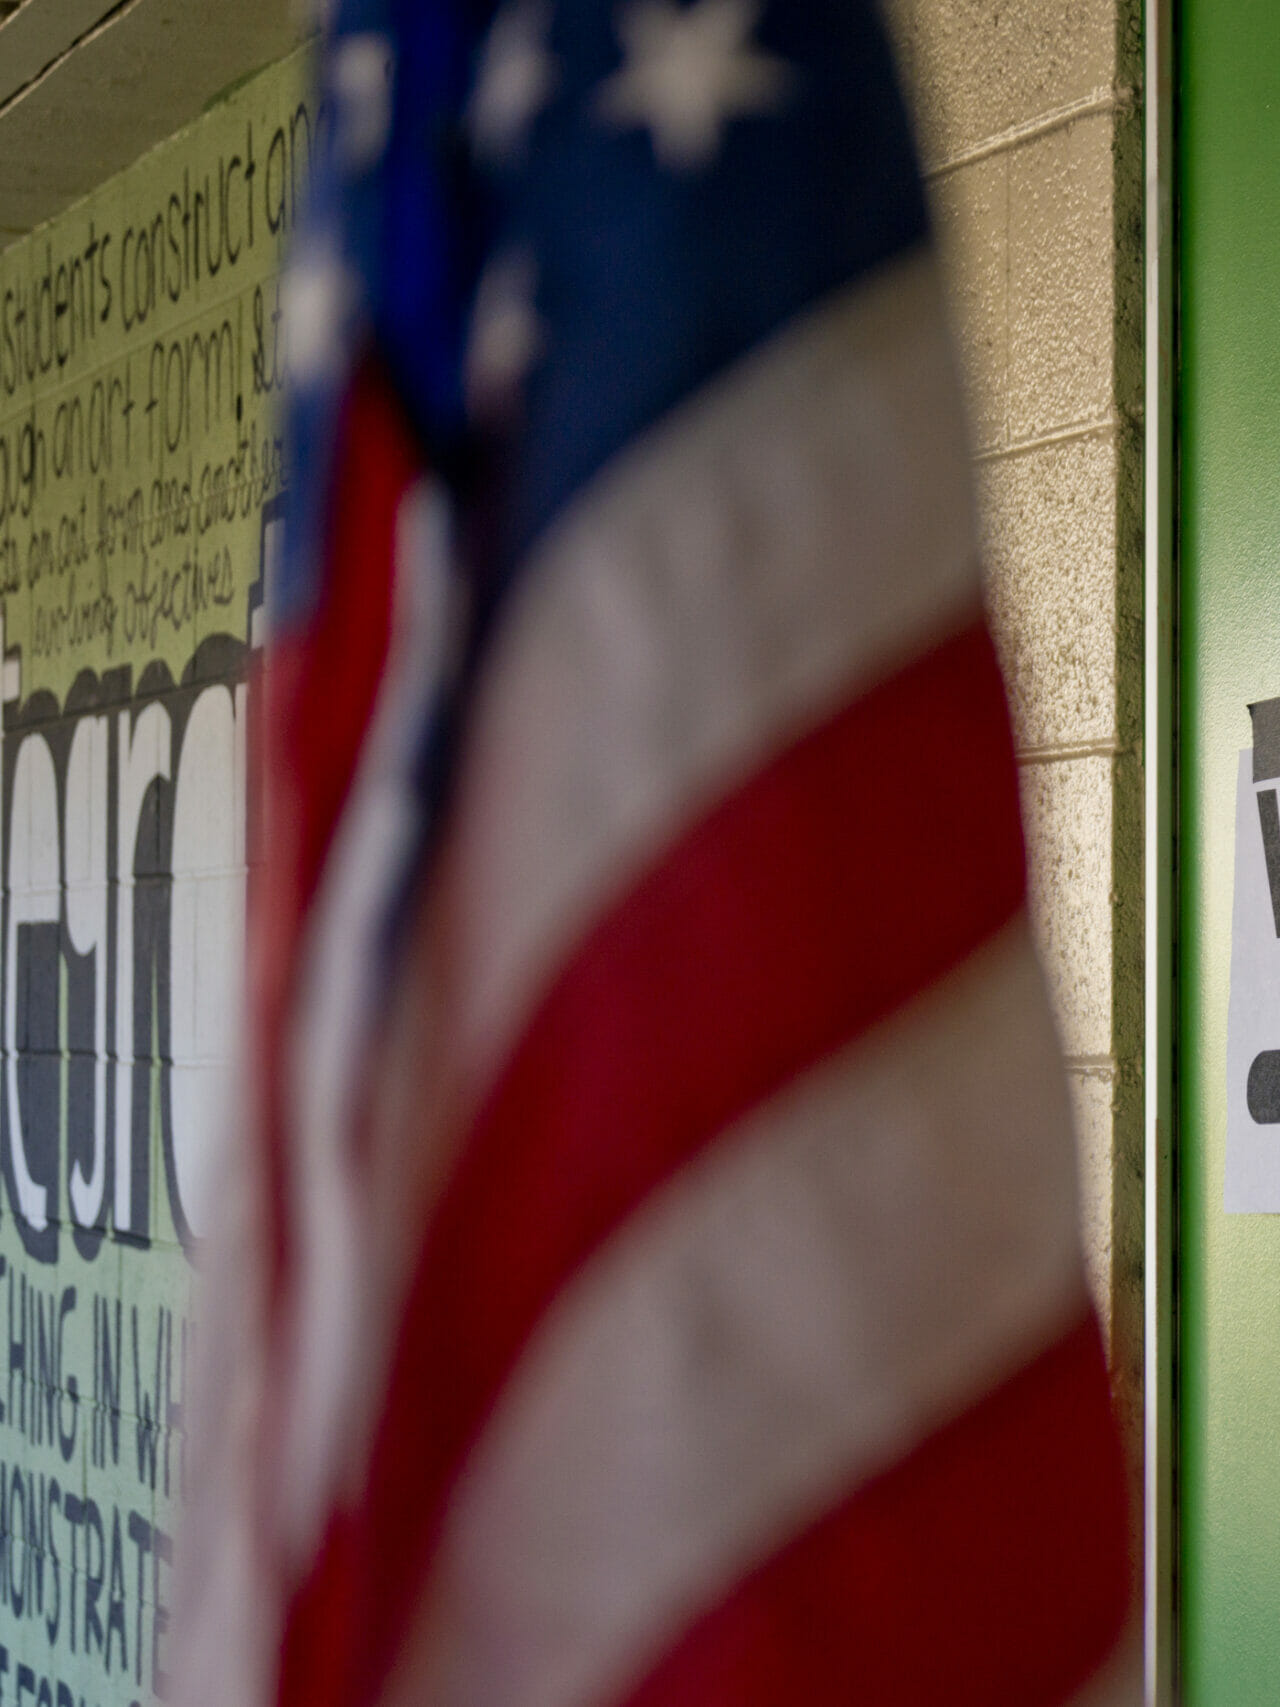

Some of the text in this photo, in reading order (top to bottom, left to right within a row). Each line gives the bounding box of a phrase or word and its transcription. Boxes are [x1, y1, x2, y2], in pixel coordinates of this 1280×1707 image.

[3, 101, 314, 395] students construct an
[89, 360, 135, 476] art
[0, 600, 268, 1248] egra
[0, 1256, 189, 1500] HING IN WH
